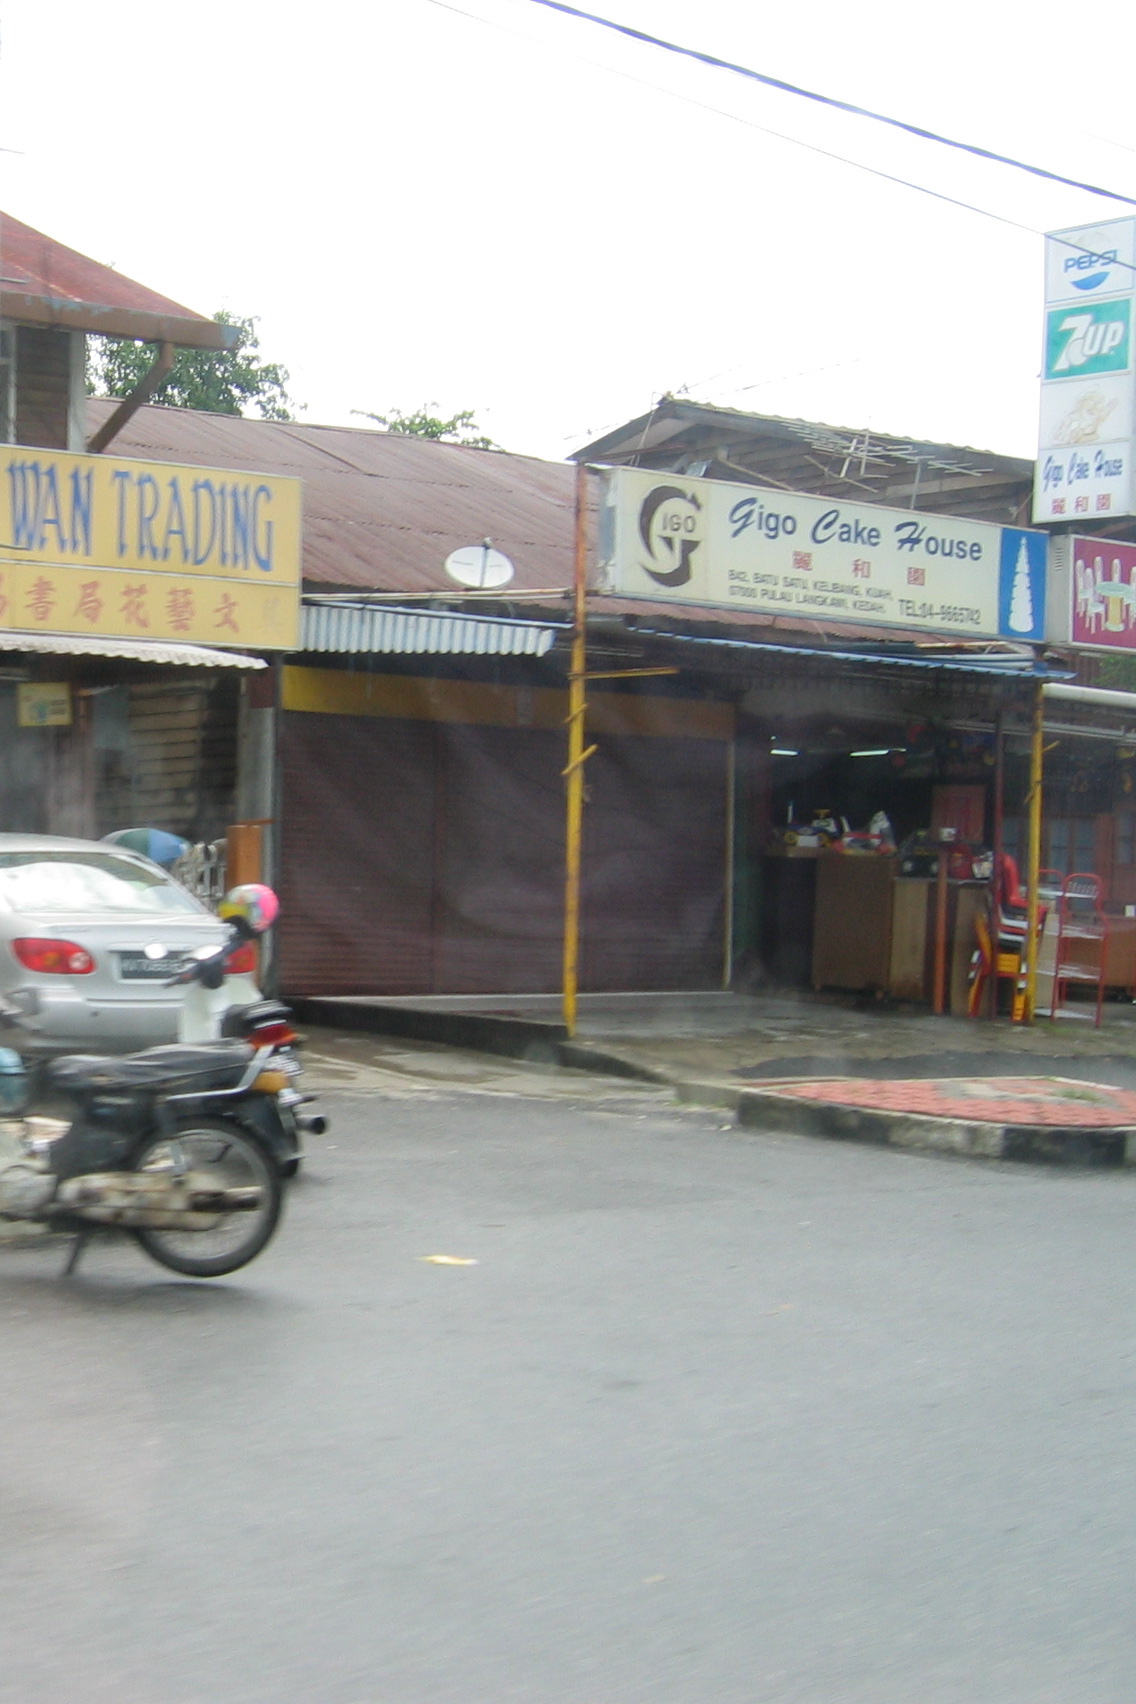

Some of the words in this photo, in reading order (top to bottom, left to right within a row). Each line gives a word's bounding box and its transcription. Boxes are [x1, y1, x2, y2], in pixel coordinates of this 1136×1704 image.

[1064, 249, 1117, 273] PEPSI
[5, 458, 93, 557] WAN
[111, 470, 274, 573] TRADING
[728, 497, 797, 540] Gigo
[811, 509, 882, 547] Cake
[894, 521, 983, 561] House
